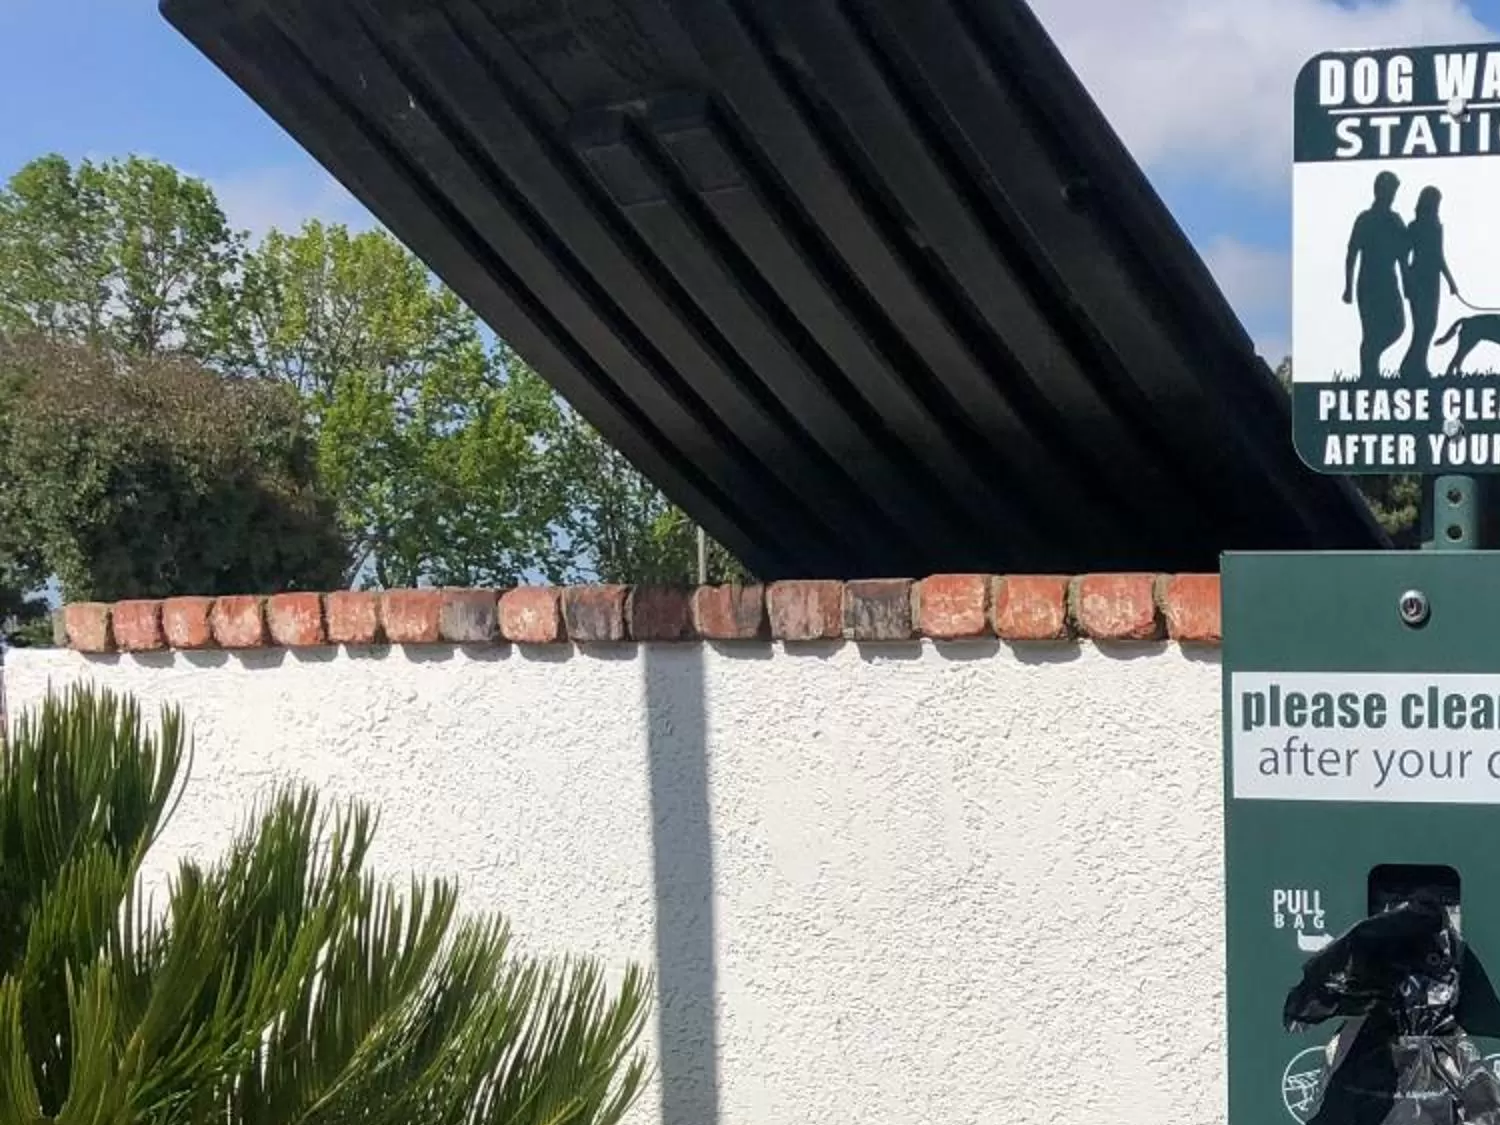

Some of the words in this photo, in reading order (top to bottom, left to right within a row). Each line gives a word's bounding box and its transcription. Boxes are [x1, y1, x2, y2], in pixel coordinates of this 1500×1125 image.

[1319, 55, 1414, 106] DOG
[1319, 388, 1430, 422] PLEASE
[1324, 433, 1416, 466] AFTER
[1241, 684, 1388, 732] please
[1258, 735, 1359, 778] after
[1372, 747, 1473, 789] your
[1273, 889, 1325, 915] PULL
[1273, 913, 1325, 929] BAG
